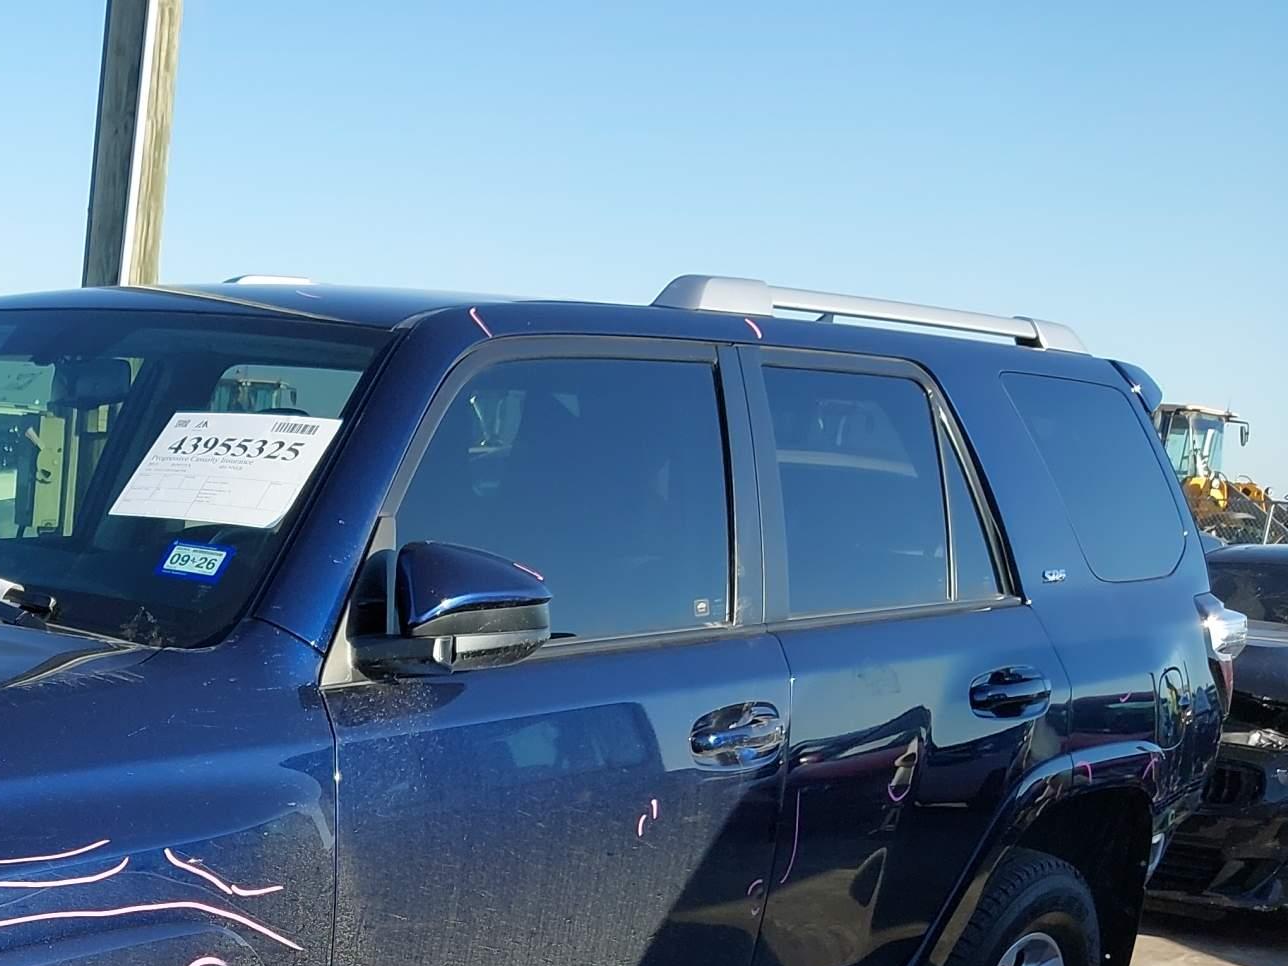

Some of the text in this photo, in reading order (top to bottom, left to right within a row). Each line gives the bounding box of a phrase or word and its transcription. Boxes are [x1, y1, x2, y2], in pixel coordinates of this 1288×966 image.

[168, 435, 305, 461] 43955325
[169, 553, 218, 571] 09 26
